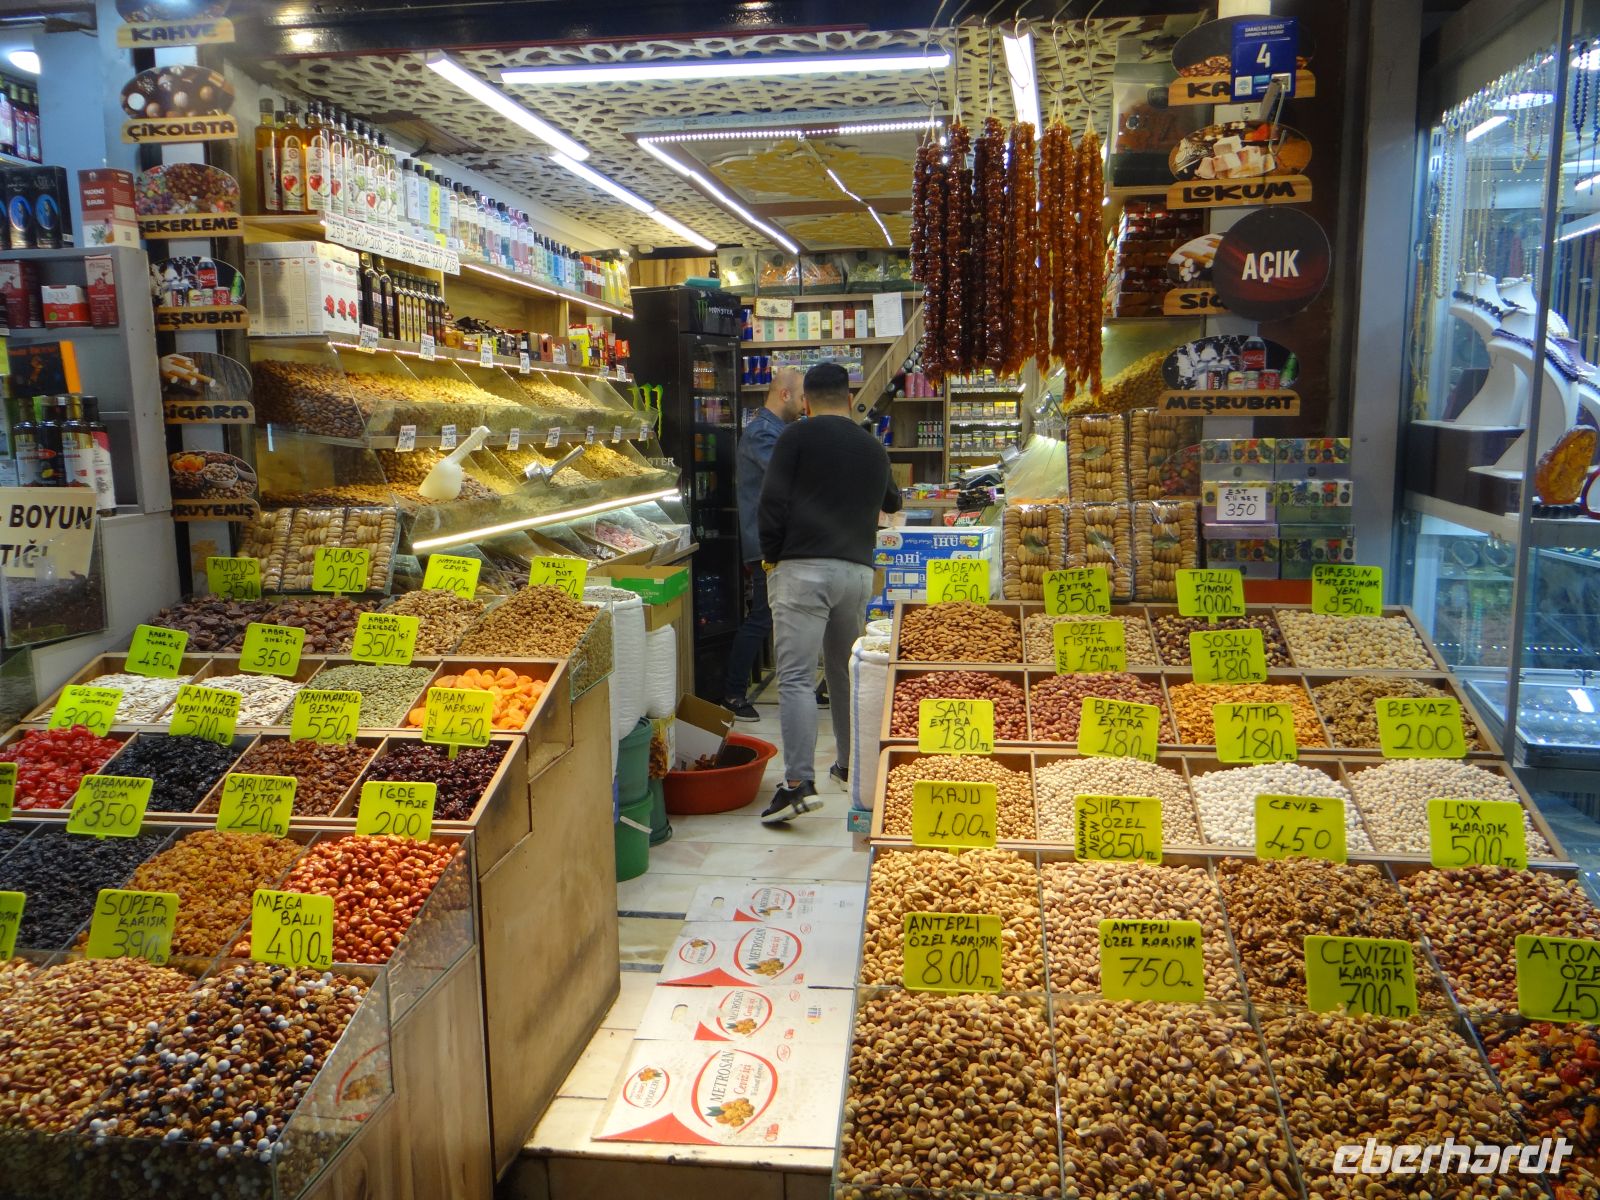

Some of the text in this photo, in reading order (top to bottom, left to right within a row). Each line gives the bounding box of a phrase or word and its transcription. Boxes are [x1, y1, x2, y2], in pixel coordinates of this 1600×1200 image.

[1256, 43, 1270, 68] 4
[127, 121, 235, 142] ÇİKOLATA
[1183, 181, 1297, 203] LOKUM
[1242, 250, 1299, 283] AÇIK
[1166, 395, 1295, 415] MEŞRUBAT
[10, 504, 93, 530] BOYUN
[1225, 503, 1256, 517] 350
[213, 559, 256, 576] KUDUS
[323, 549, 365, 566] KUDUS
[933, 561, 982, 575] BADEM
[323, 565, 360, 591] 250
[1048, 569, 1095, 584] ANTEP
[1190, 571, 1233, 583] TUZLU
[941, 584, 979, 602] 650
[1058, 582, 1093, 594] EXTRA
[1056, 593, 1095, 614] 850
[1194, 594, 1232, 614] 1000
[1324, 596, 1363, 614] 950
[357, 631, 396, 658] 350
[1064, 635, 1107, 647] FISTIK
[1202, 634, 1252, 649] SOSLU
[137, 651, 171, 667] 450
[253, 647, 291, 668] 350
[1209, 649, 1251, 659] FISTIK
[1211, 658, 1250, 682] 180
[181, 687, 238, 706] KAN TAZE
[431, 690, 466, 702] YABAN
[59, 707, 103, 728] 300
[935, 703, 973, 718] SARI
[1094, 700, 1149, 720] BEYAZ
[1231, 705, 1284, 725] KITIR
[1387, 703, 1455, 718] BEYAZ
[306, 714, 349, 740] 550
[425, 711, 437, 740] TAZE
[442, 715, 484, 741] 450
[930, 718, 971, 728] EXTRA
[1097, 717, 1144, 729] EXTRA
[939, 726, 980, 751] 180
[1098, 729, 1142, 757] 180
[1236, 726, 1284, 761] 180
[1392, 724, 1454, 750] 200
[84, 777, 145, 790] KARAMAN
[228, 776, 257, 792] SARI
[241, 793, 283, 805] EXTRA
[395, 799, 429, 810] TAZE
[931, 786, 981, 805] KAJU
[85, 800, 137, 828] 350
[226, 804, 273, 833] 220
[368, 811, 422, 836] 200
[928, 810, 983, 839] 400
[1089, 821, 1100, 852] NEW
[1099, 830, 1144, 859] 850
[1264, 825, 1332, 852] 450
[1451, 834, 1503, 866] 500
[256, 893, 303, 912] MEGA
[265, 928, 322, 964] 400
[749, 928, 767, 962] METROSAN
[922, 949, 979, 985] 800
[1119, 957, 1184, 988] 750
[1340, 982, 1392, 1017] 700
[710, 1050, 735, 1103] METROSAN
